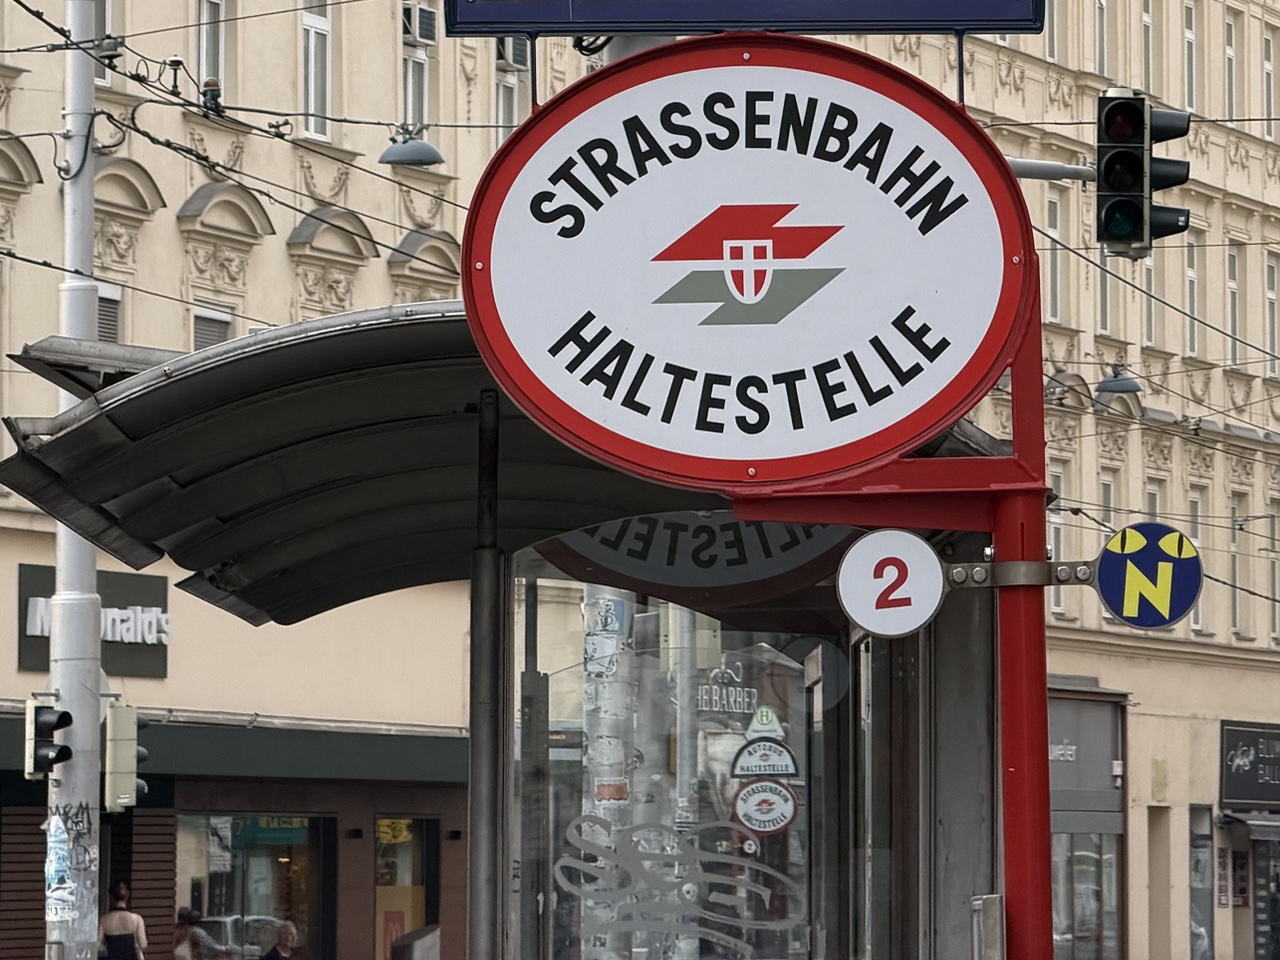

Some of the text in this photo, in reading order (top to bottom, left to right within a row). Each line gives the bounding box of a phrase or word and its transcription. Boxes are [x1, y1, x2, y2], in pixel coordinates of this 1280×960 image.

[529, 91, 969, 239] STRASSENBAHN
[547, 304, 951, 435] HALTESTELLE
[873, 556, 912, 610] 2
[1122, 559, 1174, 620] N
[711, 685, 758, 714] BARBER
